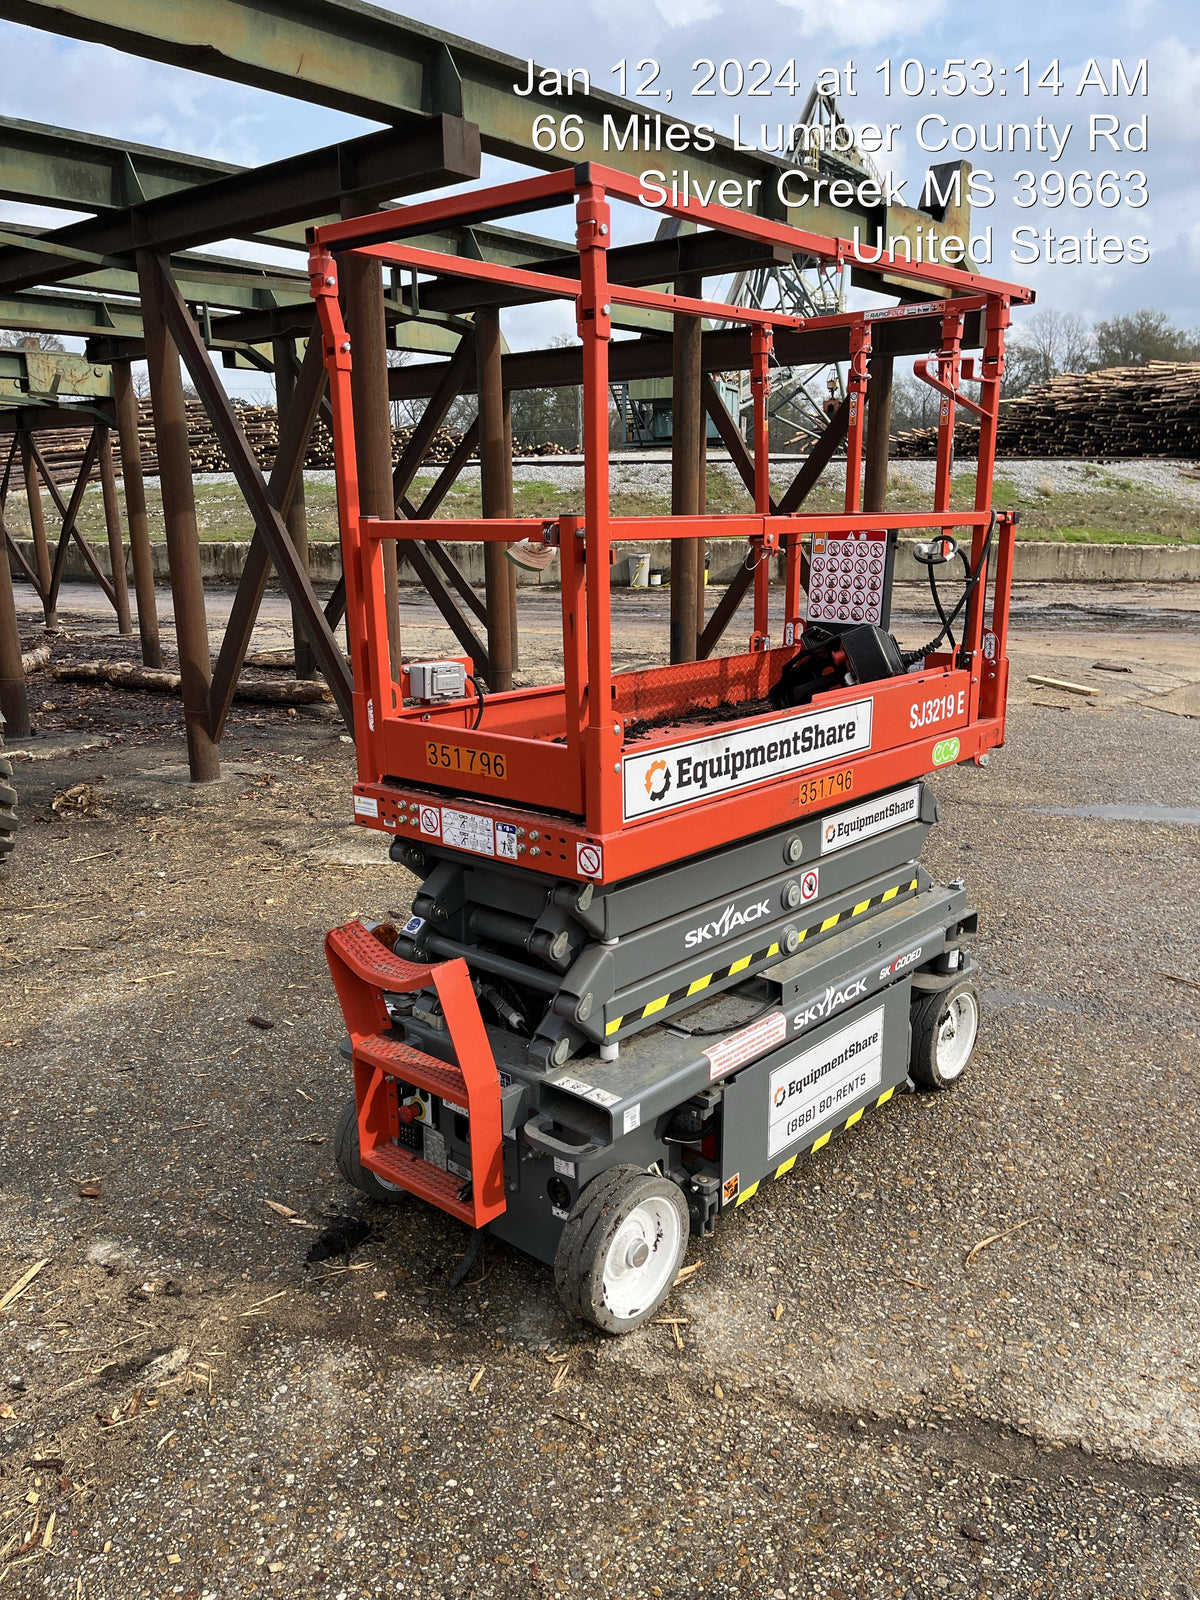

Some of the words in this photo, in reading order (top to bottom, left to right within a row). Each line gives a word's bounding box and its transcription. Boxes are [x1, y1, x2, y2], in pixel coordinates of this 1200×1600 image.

[910, 694, 956, 729] SJ3219
[957, 690, 966, 715] E
[428, 743, 505, 778] 351796
[676, 721, 856, 789] EquipmentShare
[934, 740, 959, 763] eco
[800, 770, 853, 805] 351796
[837, 798, 915, 838] EquipmentShare
[684, 898, 770, 949] SKYJACK
[879, 947, 922, 980] SKYCODED
[793, 977, 868, 1032] SKYJACK
[788, 1028, 879, 1098] EquipmentShare
[786, 1106, 817, 1137] (888)
[819, 1073, 867, 1114] 80-RENTS
